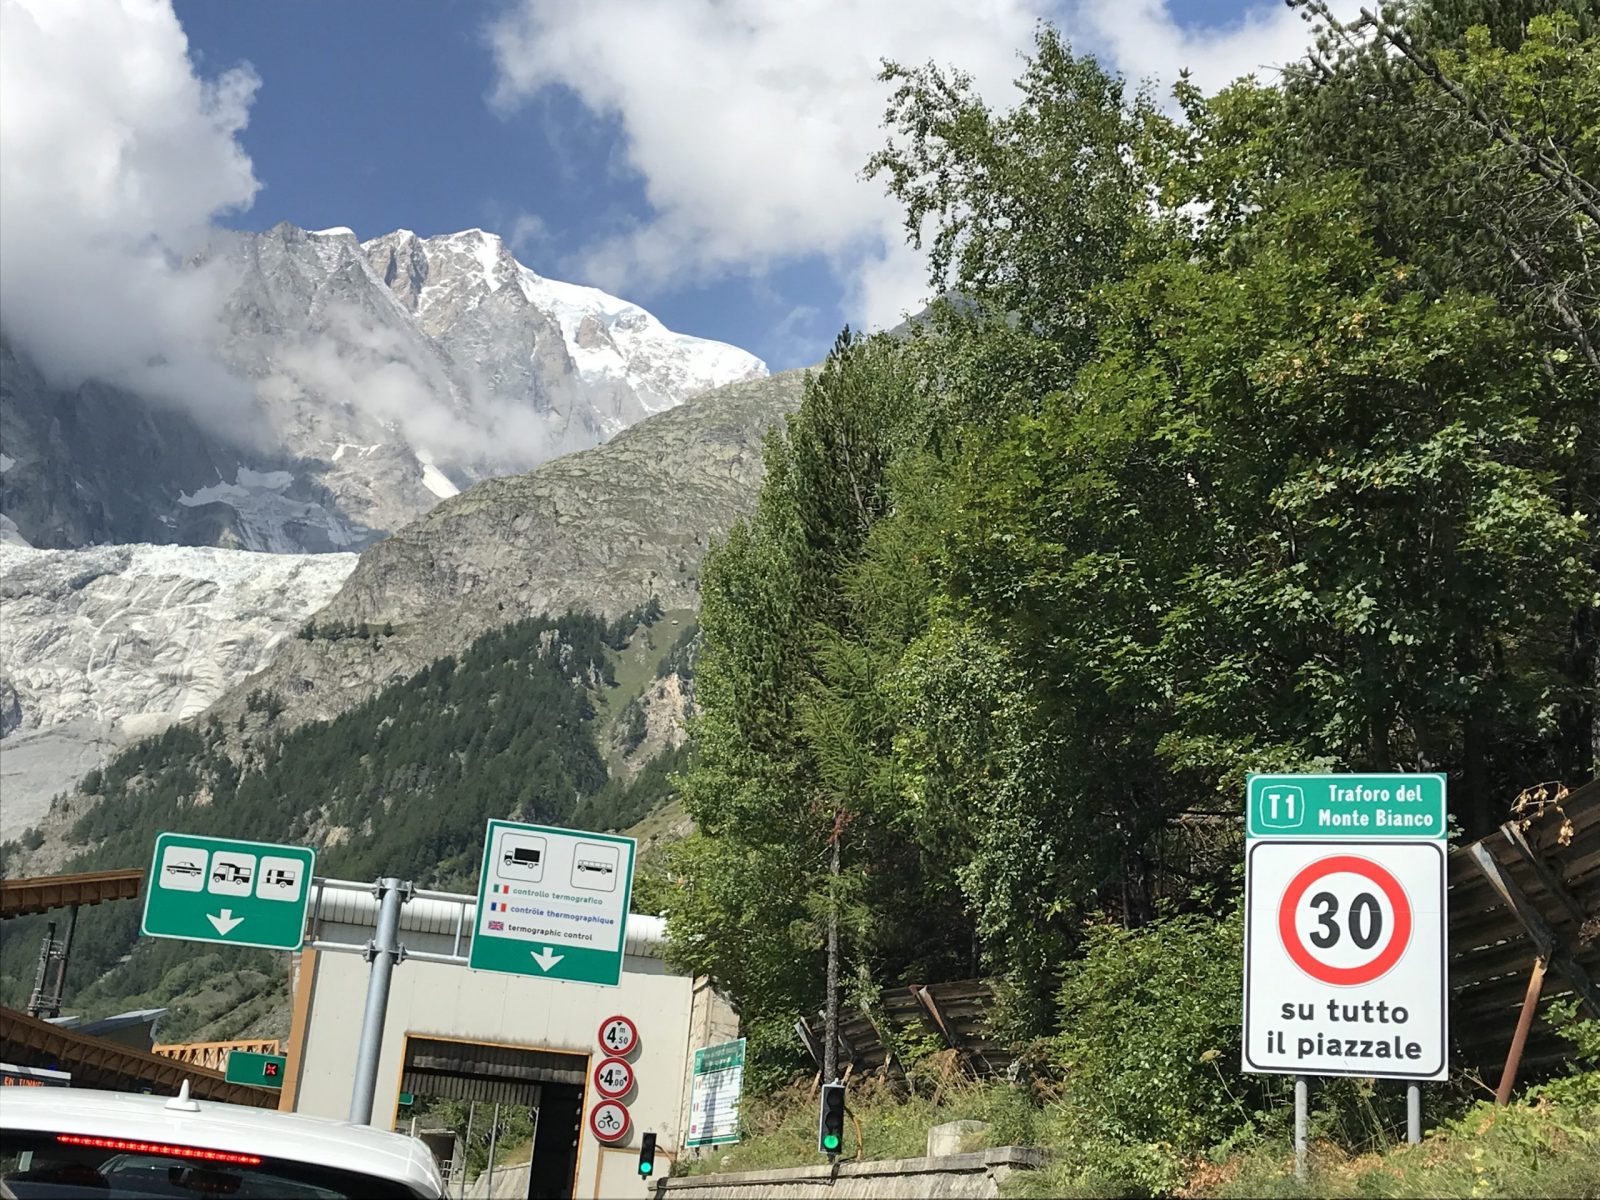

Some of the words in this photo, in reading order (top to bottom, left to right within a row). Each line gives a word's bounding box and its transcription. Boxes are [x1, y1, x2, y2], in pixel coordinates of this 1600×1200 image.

[1328, 784, 1390, 803] Traforo
[1395, 784, 1423, 803] del
[1267, 793, 1296, 820] T1
[1318, 809, 1370, 828] Monte
[1375, 809, 1434, 828] Bianco
[512, 887, 550, 899] controllo
[552, 892, 603, 905] termografico
[547, 910, 614, 925] thermographique
[1309, 891, 1383, 950] 30
[508, 924, 562, 937] termographic
[563, 931, 593, 942] control
[1280, 1001, 1315, 1021] su
[1327, 998, 1409, 1024] tutto
[1267, 1030, 1286, 1055] il
[1297, 1033, 1423, 1060] piazzale
